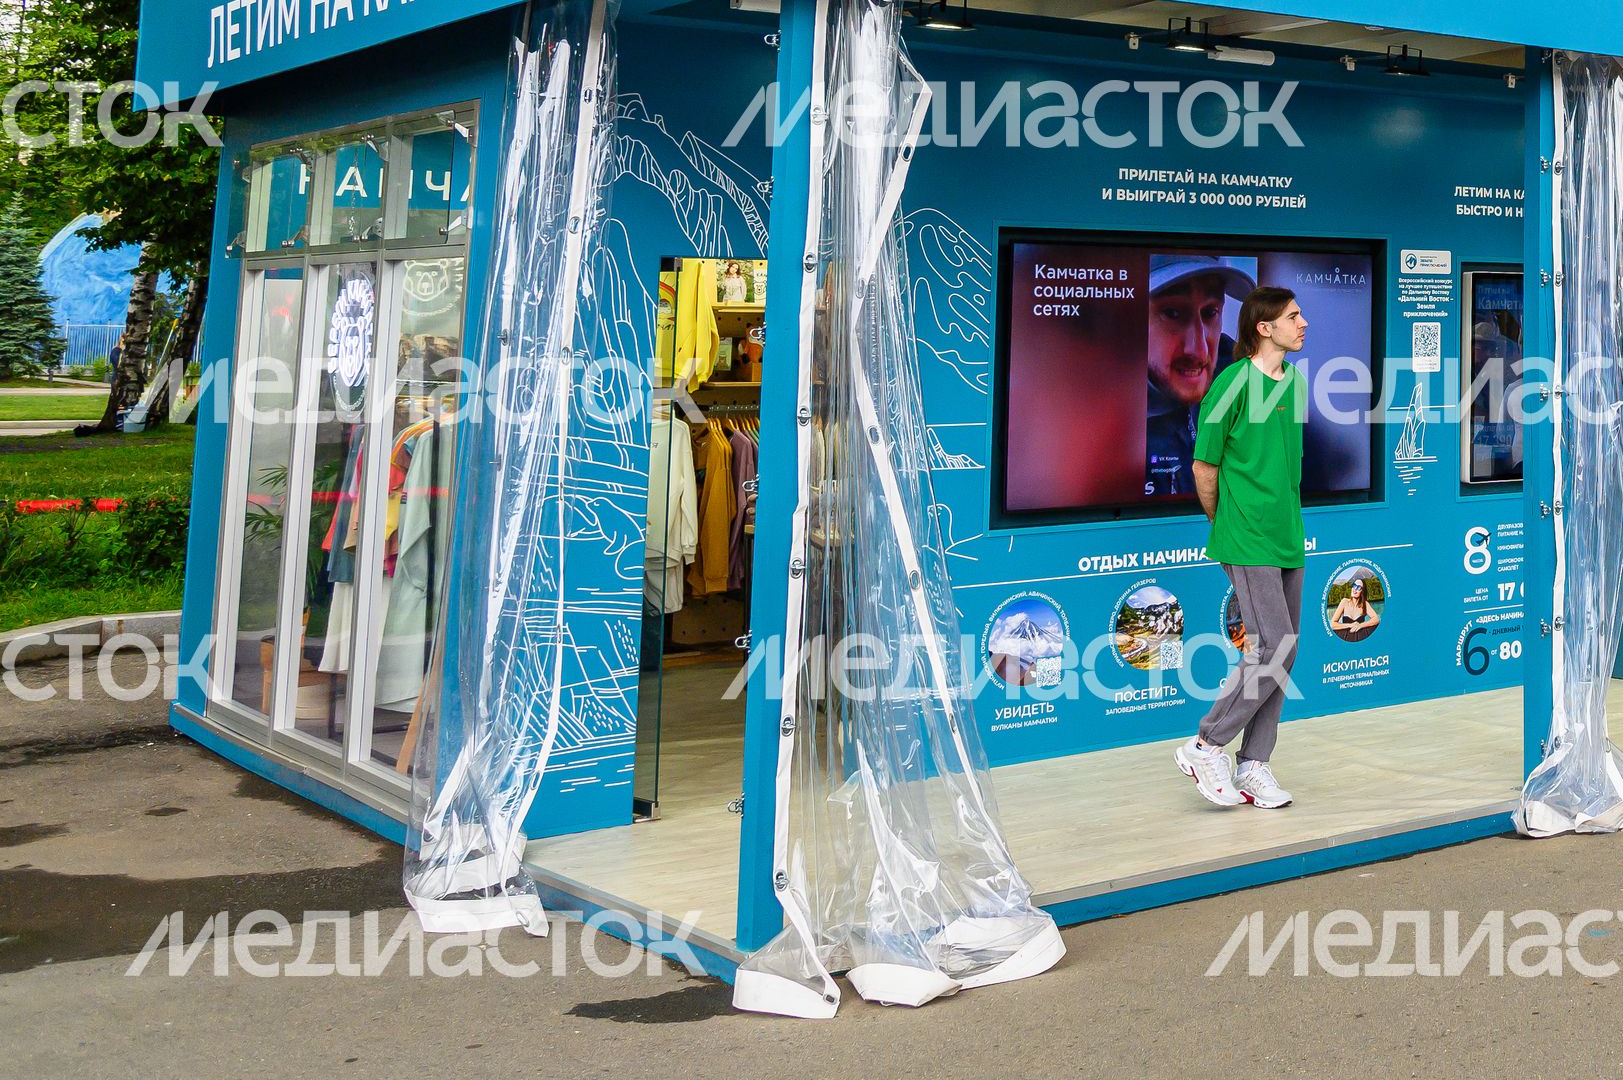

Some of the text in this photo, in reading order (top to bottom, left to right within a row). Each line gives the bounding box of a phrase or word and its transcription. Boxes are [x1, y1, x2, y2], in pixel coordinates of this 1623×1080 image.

[1118, 168, 1293, 188] ПРИЛЕТАЙ НА КАМЧАТКУ
[1102, 188, 1307, 209] И ВЫИГРАЙ 3 000 000 РУБЛЕЙ
[1454, 186, 1492, 198] ЛЕТИМ
[1496, 189, 1511, 199] НА
[1456, 204, 1501, 217] БЫСТРО
[1505, 206, 1513, 217] И
[1035, 264, 1128, 281] Камчатка в
[1296, 267, 1367, 285] КАМЧАТКА
[1034, 285, 1135, 301] социальных
[1033, 303, 1080, 317] сетях
[1464, 526, 1491, 575] 8
[1078, 553, 1138, 573] ОТДЫХ
[1498, 582, 1515, 601] 17
[1476, 615, 1500, 624] «ЗДЕСЬ
[1456, 620, 1473, 666] МАРШРУТ
[1464, 627, 1490, 676] 6
[1492, 625, 1521, 635] ДНЕВНЫЙ
[1500, 640, 1522, 660] 80
[1323, 655, 1389, 674] ИСКУПАТЬСЯ
[1327, 673, 1355, 683] ЛЕЧЕБНЫХ
[1356, 669, 1389, 680] ТЕРМАЛЬНЫХ
[1340, 680, 1373, 689] ИСТОЧНИКАХ
[1114, 685, 1177, 703] ПОСЕТИТЬ
[995, 702, 1055, 720] УВИДЕТЬ
[1105, 699, 1185, 716] ЗАПОВЕДНЫЕ ТЕРРИТОРИИ
[991, 716, 1058, 732] ВУЛКАНЫ КАМЧАТКИ
